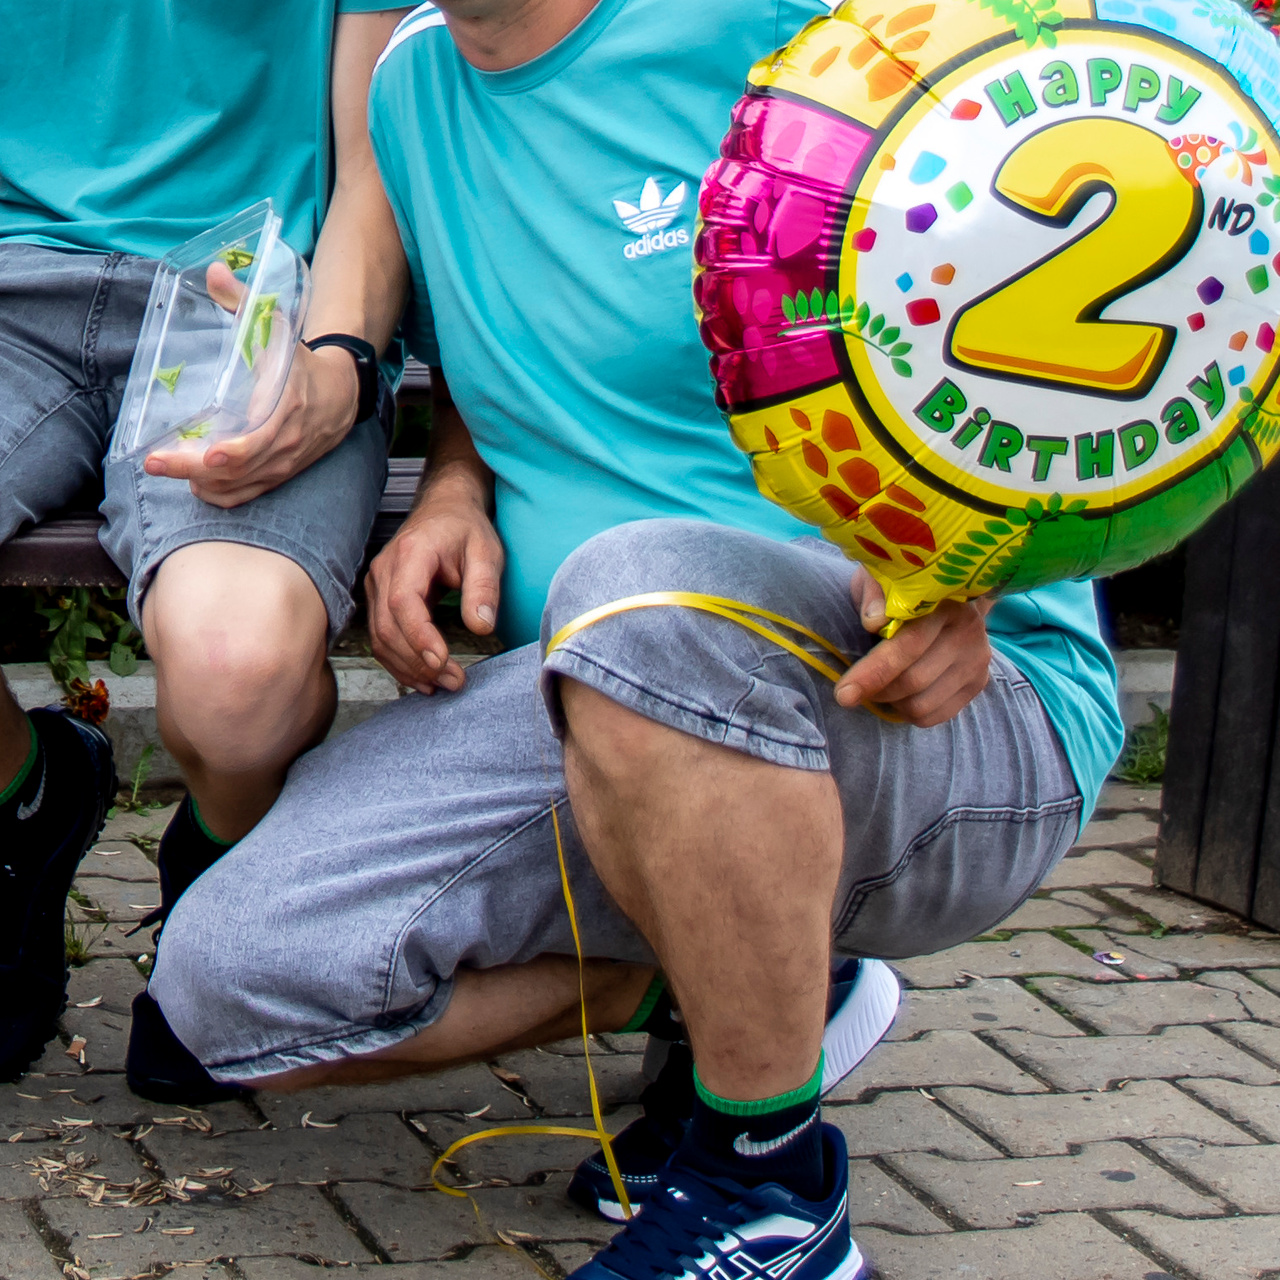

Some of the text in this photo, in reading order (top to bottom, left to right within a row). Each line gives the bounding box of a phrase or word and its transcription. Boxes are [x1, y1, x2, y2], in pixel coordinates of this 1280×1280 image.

[623, 228, 690, 259] adidas
[942, 115, 1256, 401] 2 ND
